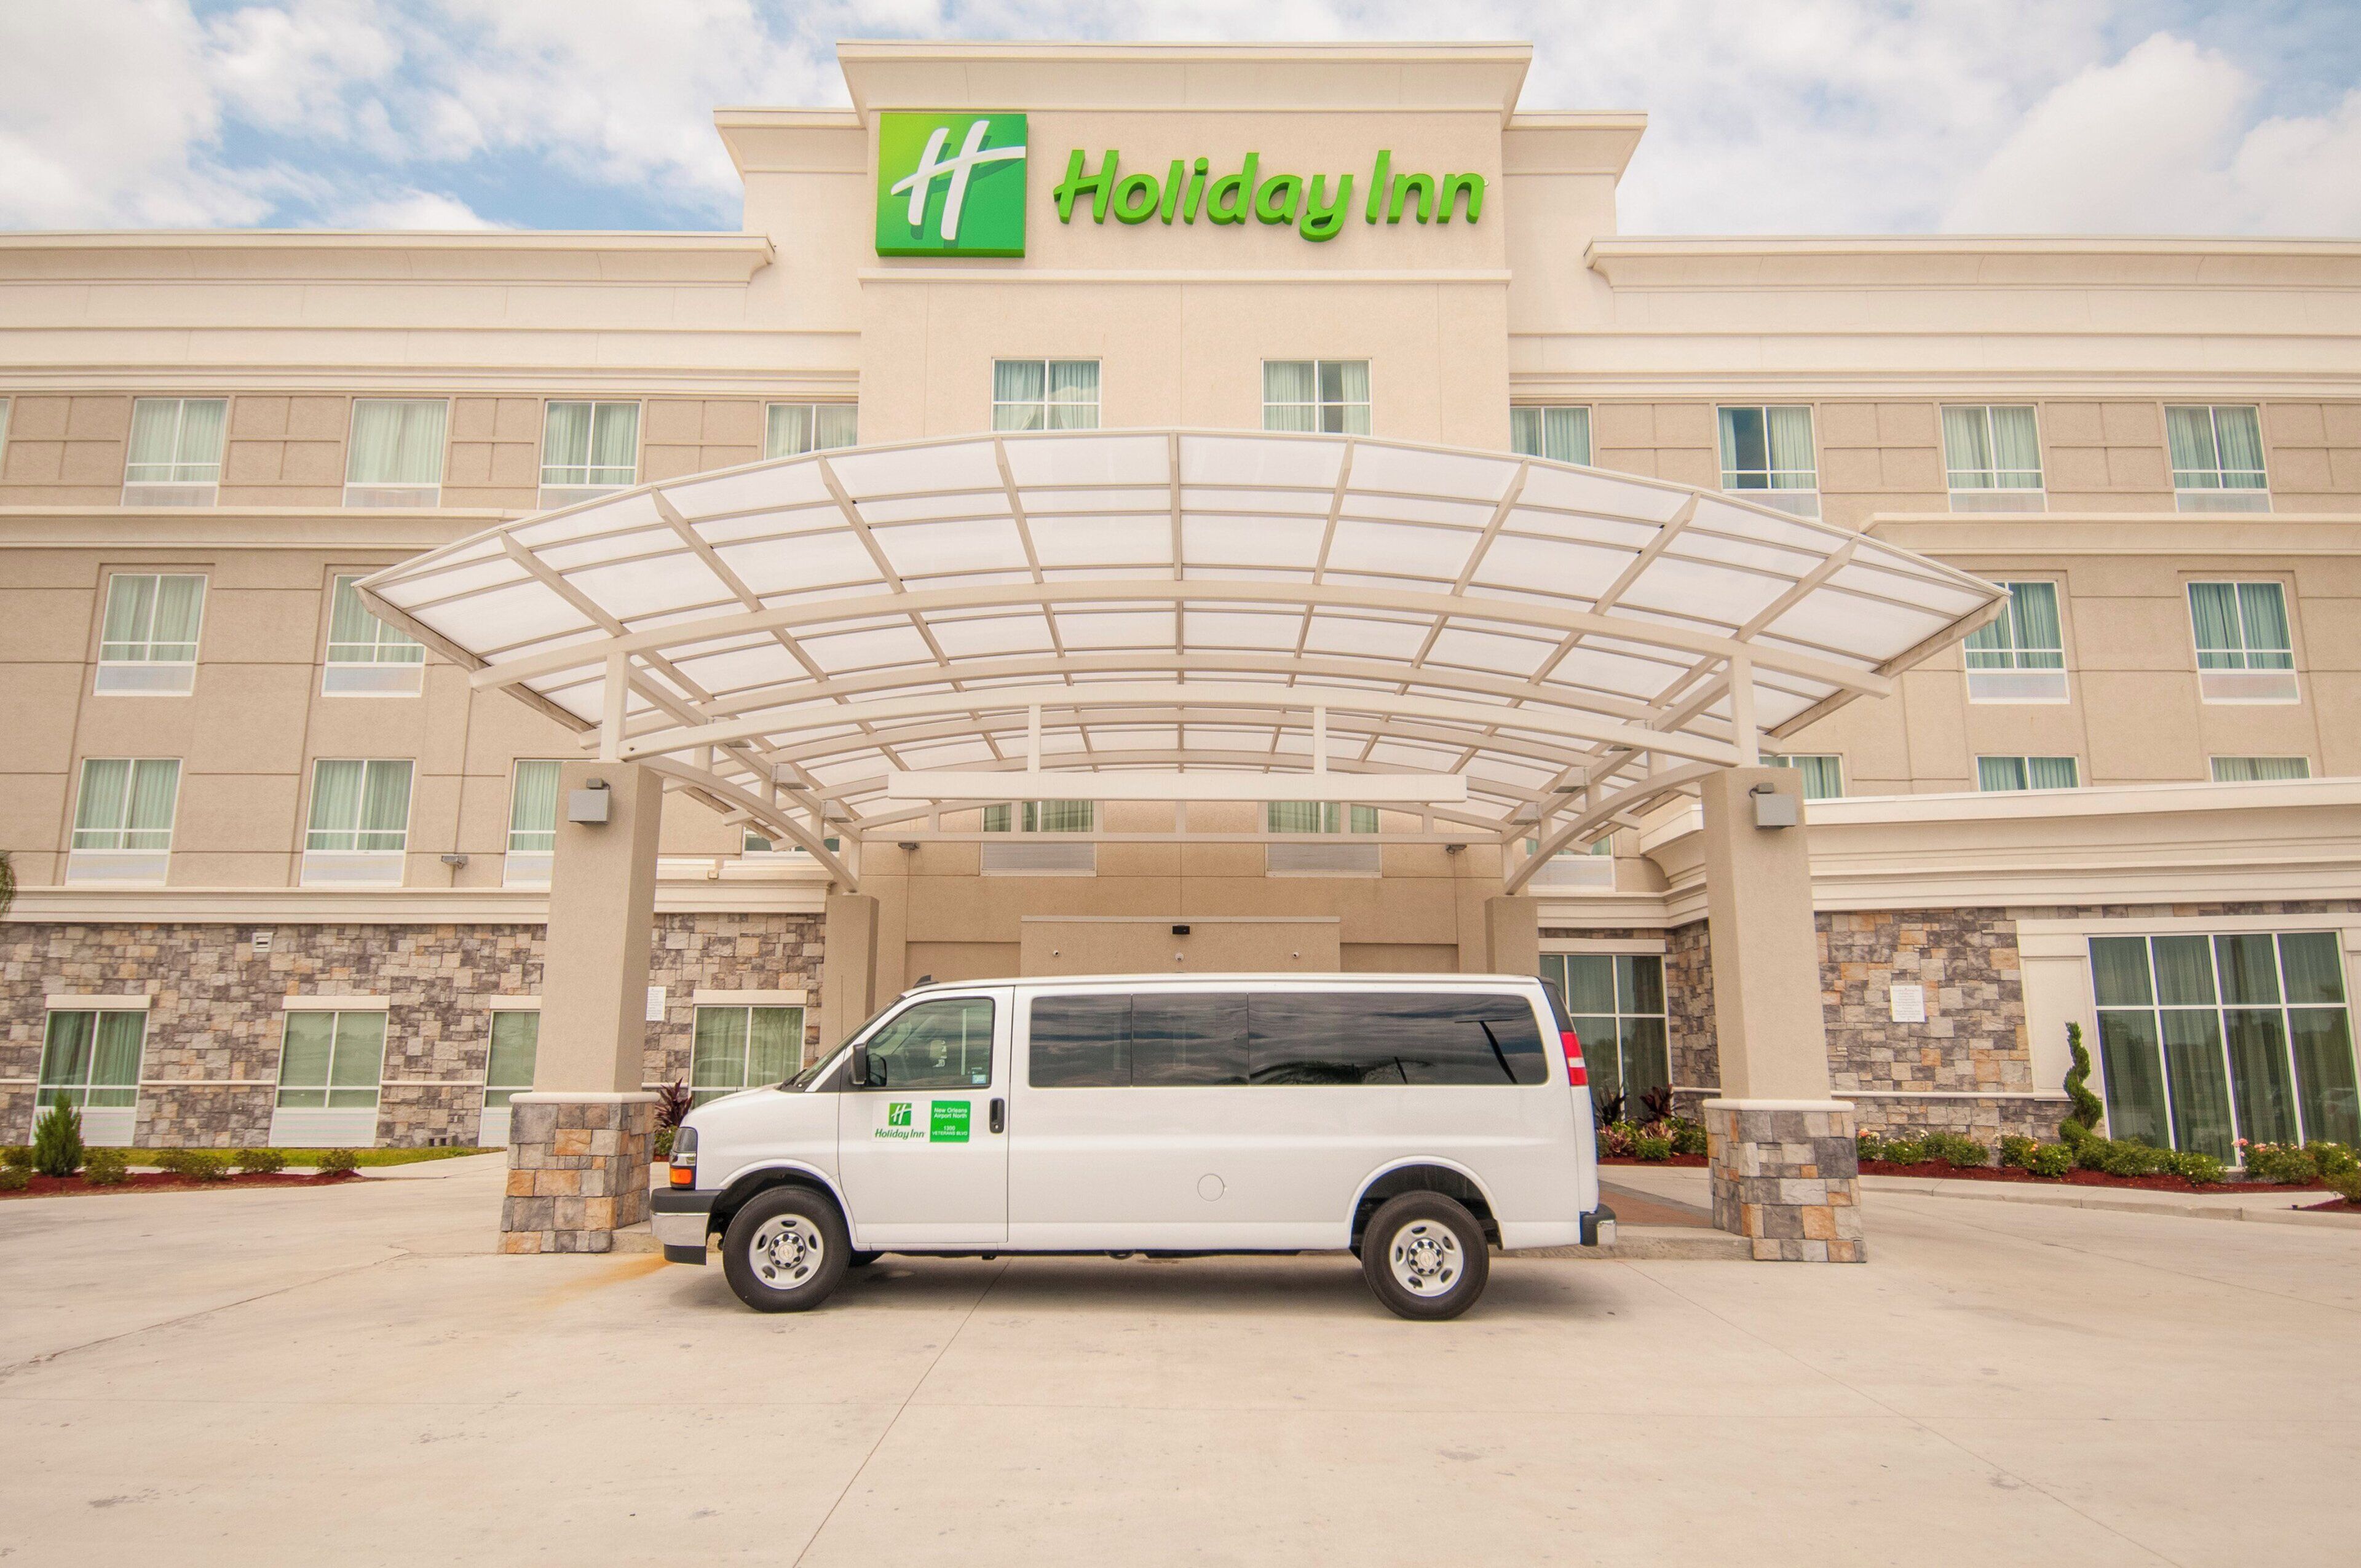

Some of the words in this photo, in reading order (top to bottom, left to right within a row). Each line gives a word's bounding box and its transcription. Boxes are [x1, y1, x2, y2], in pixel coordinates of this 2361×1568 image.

[1053, 149, 1353, 242] Holiday
[1365, 149, 1485, 225] Inn
[875, 1128, 909, 1140] Holiday
[911, 1128, 925, 1138] Inn
